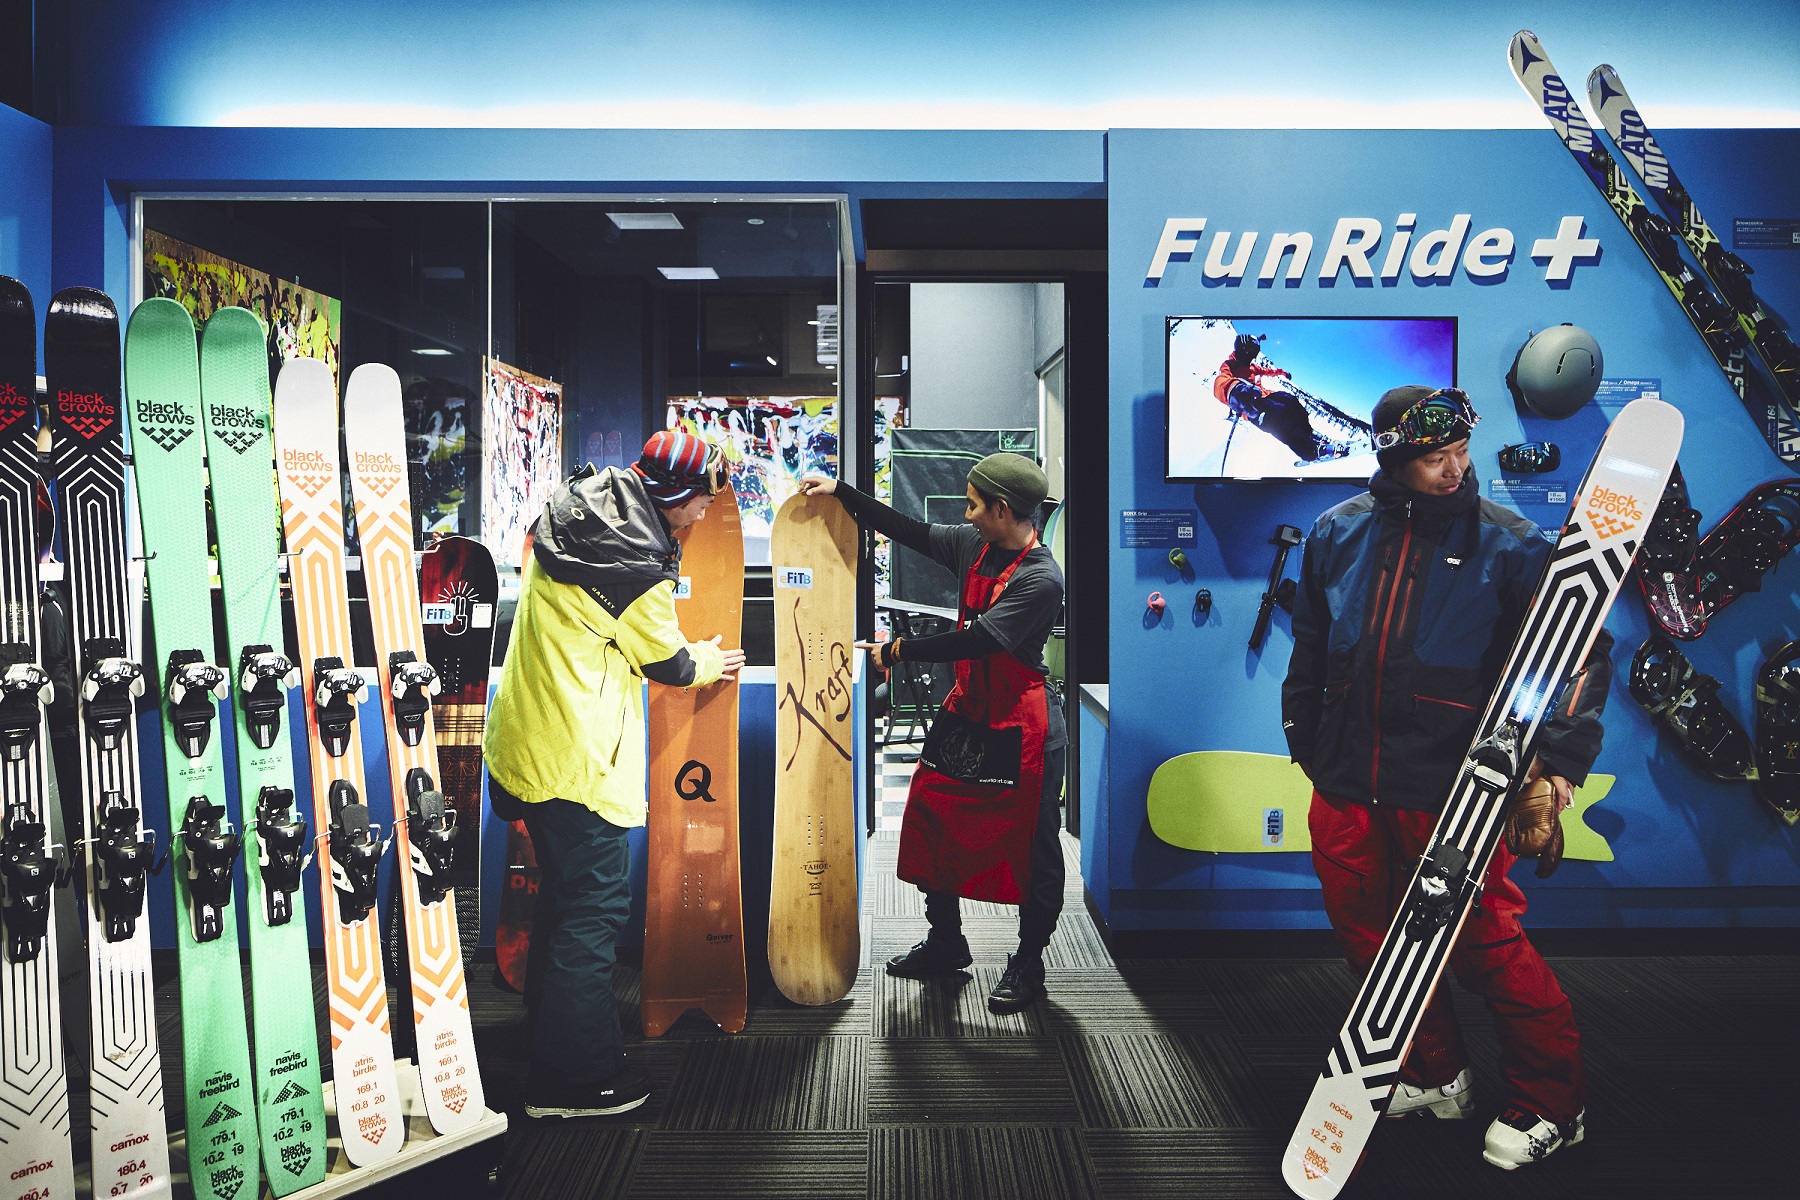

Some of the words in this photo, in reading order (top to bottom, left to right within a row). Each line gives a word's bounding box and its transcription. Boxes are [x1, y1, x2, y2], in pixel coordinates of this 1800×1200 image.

[1542, 74, 1568, 126] ATO
[1620, 109, 1645, 159] ATO
[57, 390, 105, 404] black
[58, 403, 115, 415] crows
[136, 399, 184, 415] black
[210, 404, 255, 418] black
[138, 412, 195, 425] crows
[211, 416, 265, 429] crows
[283, 448, 324, 462] black
[355, 451, 393, 464] black
[284, 461, 333, 472] crows
[356, 463, 402, 473] crows
[1591, 485, 1638, 509] black
[1589, 497, 1643, 521] crows
[591, 586, 616, 610] OAKLEY
[778, 596, 853, 772] Kraft
[674, 759, 717, 802] Q
[803, 863, 829, 871] TAHOE
[434, 1037, 457, 1051] birdie
[436, 1030, 454, 1042] atris
[275, 1051, 301, 1066] navis
[354, 1056, 374, 1068] atris
[438, 1055, 459, 1067] 169.1
[269, 1058, 308, 1077] freebird
[352, 1064, 377, 1078] birdie
[433, 1072, 450, 1084] 10.8
[455, 1066, 466, 1077] 20
[205, 1071, 233, 1088] navis
[356, 1081, 378, 1095] 169.1
[199, 1078, 240, 1099] freebird
[441, 1083, 462, 1097] black
[442, 1089, 468, 1103] crows
[350, 1100, 369, 1113] 10.8
[374, 1094, 386, 1105] 20
[1329, 1101, 1353, 1121] nocta
[280, 1108, 305, 1123] 179.1
[358, 1112, 381, 1127] black
[272, 1127, 294, 1142] 10.2
[300, 1121, 312, 1133] 19
[359, 1118, 387, 1133] crows
[1323, 1120, 1344, 1139] 185.5
[110, 1133, 150, 1153] camox
[210, 1130, 236, 1147] 179.1
[1310, 1128, 1327, 1144] 12.2
[1330, 1142, 1343, 1154] 26
[202, 1151, 225, 1167] 10.2
[231, 1144, 244, 1156] 19
[280, 1141, 306, 1157] black
[281, 1146, 312, 1163] crows
[1306, 1147, 1328, 1166] black
[10, 1160, 54, 1181] camox
[117, 1159, 147, 1177] 180.4
[210, 1164, 238, 1181] black
[1304, 1154, 1329, 1174] crows
[110, 1183, 129, 1197] 9.7
[139, 1174, 154, 1187] 20
[211, 1170, 244, 1188] crows
